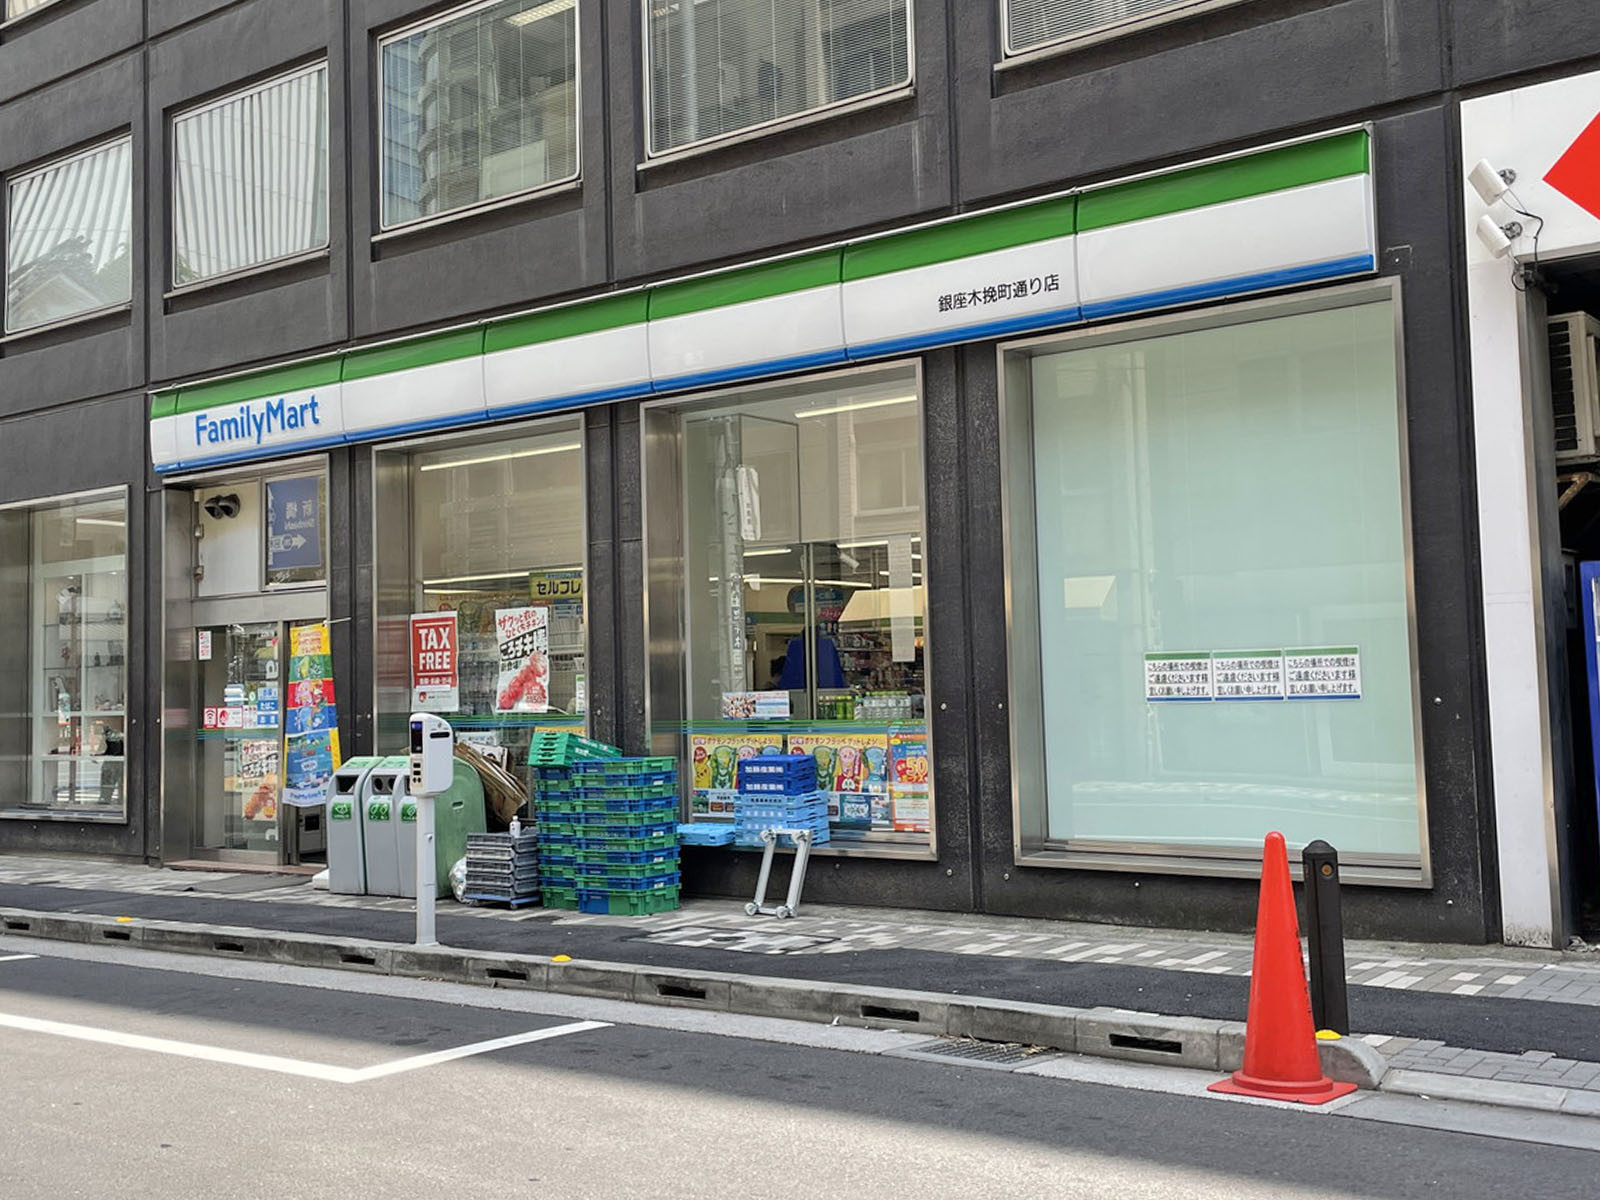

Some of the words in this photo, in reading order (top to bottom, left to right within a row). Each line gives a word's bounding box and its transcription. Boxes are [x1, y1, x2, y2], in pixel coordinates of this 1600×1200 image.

[938, 274, 1059, 312] 銀座木挽町通り店
[195, 395, 319, 445] FamilyMart
[418, 627, 451, 650] TAX
[419, 651, 451, 670] FREE
